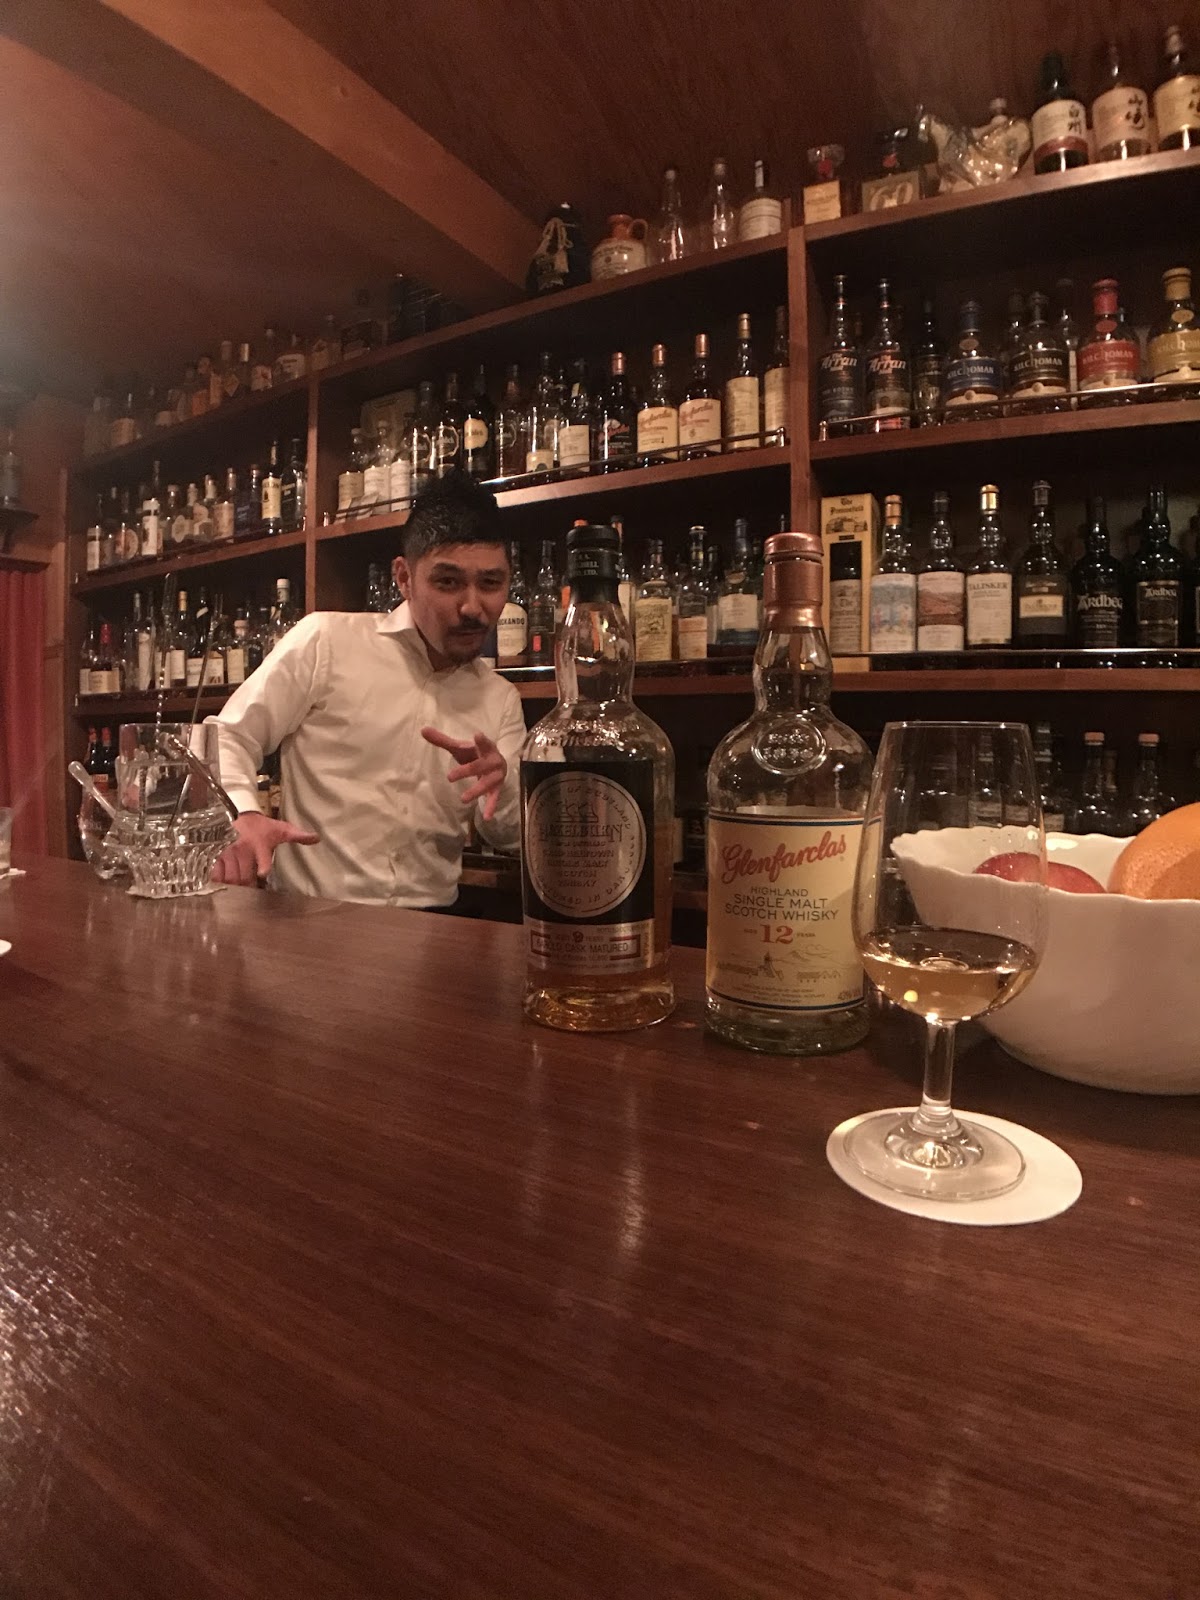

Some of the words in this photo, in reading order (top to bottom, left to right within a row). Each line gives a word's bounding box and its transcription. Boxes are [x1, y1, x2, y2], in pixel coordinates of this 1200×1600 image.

[868, 358, 907, 373] Arran
[721, 831, 847, 885] Glenfarclas
[751, 886, 808, 897] HIGHLAND
[734, 893, 784, 909] SINGLE
[790, 898, 828, 909] MALT
[725, 903, 777, 920] SCOTCH
[782, 909, 840, 922] WHISKY
[760, 924, 794, 945] 12
[589, 942, 629, 953] MATURED
